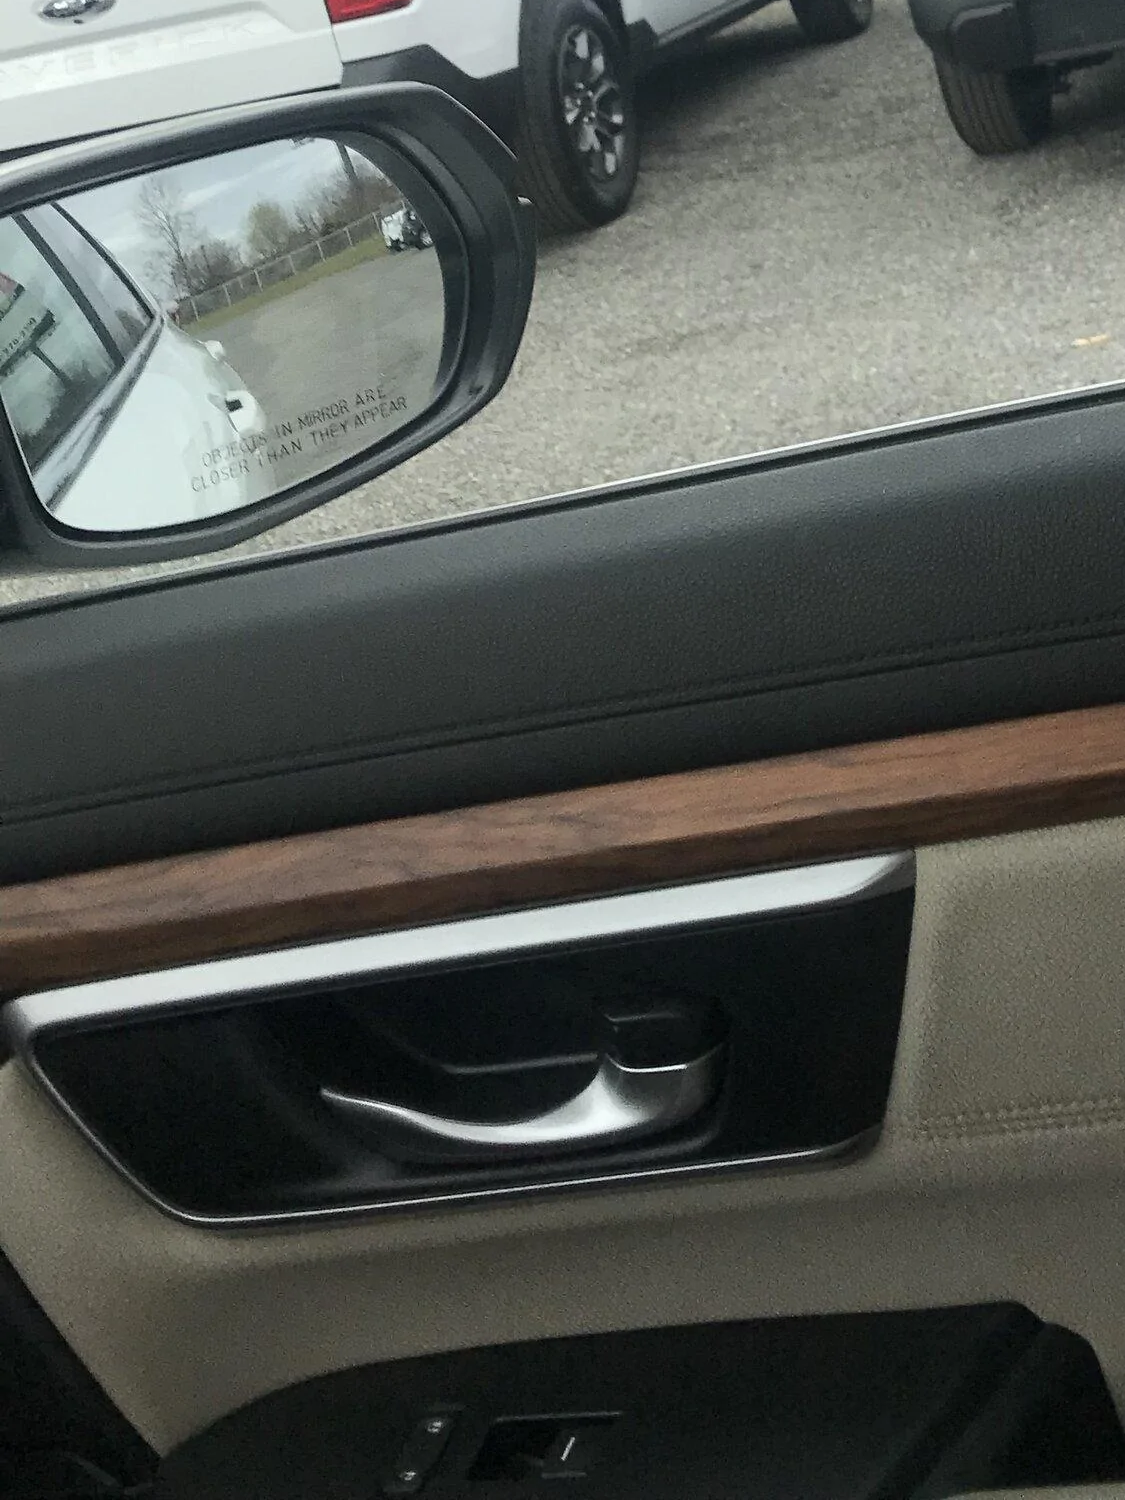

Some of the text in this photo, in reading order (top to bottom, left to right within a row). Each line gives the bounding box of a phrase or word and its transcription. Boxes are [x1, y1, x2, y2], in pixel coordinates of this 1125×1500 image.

[190, 396, 408, 492] CLOSER THAN THEY APPEAR
[202, 387, 386, 468] OBJECTS IN MIRROR ARE
